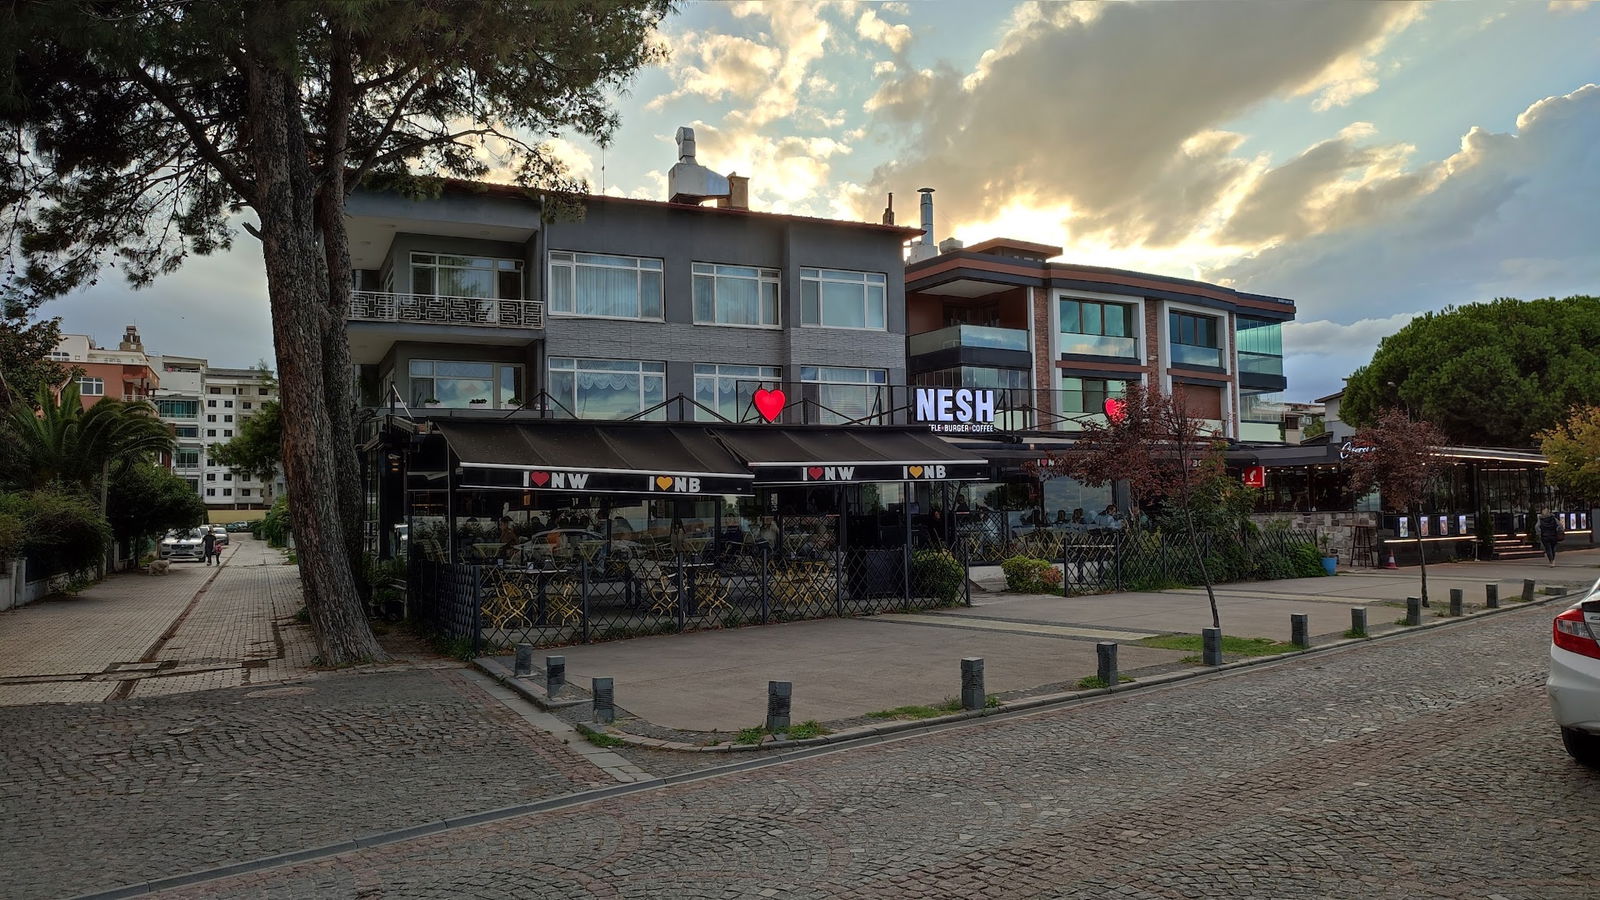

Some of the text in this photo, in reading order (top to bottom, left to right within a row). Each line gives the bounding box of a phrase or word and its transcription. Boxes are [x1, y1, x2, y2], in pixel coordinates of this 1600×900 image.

[916, 388, 995, 422] NESH
[928, 424, 994, 433] FLE BURGER COFFEE
[523, 471, 589, 489] I NW
[802, 466, 855, 481] I NW
[902, 465, 947, 479] I NB
[649, 475, 701, 493] I NB
